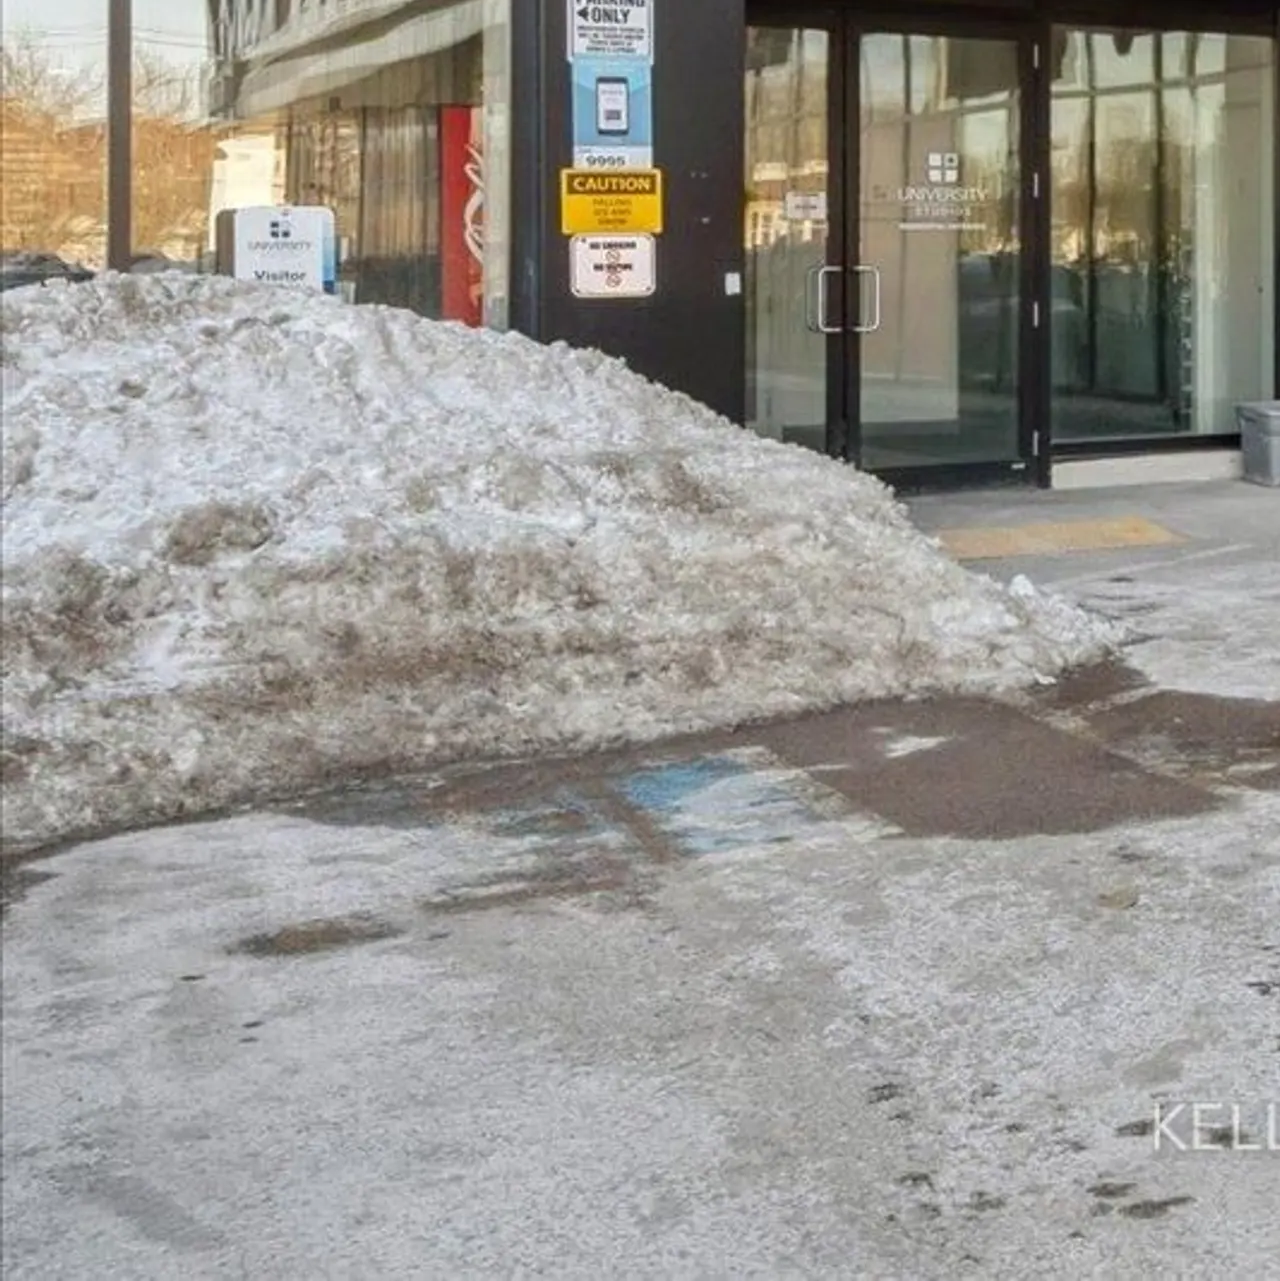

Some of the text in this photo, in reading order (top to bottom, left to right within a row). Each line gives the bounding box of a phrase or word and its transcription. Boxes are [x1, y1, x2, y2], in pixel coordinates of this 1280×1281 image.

[590, 6, 631, 24] ONLY
[572, 176, 651, 192] CAUTION
[897, 187, 989, 201] UNIVERSITY
[247, 241, 312, 252] UNIVERSITY
[253, 270, 307, 282] Visitor
